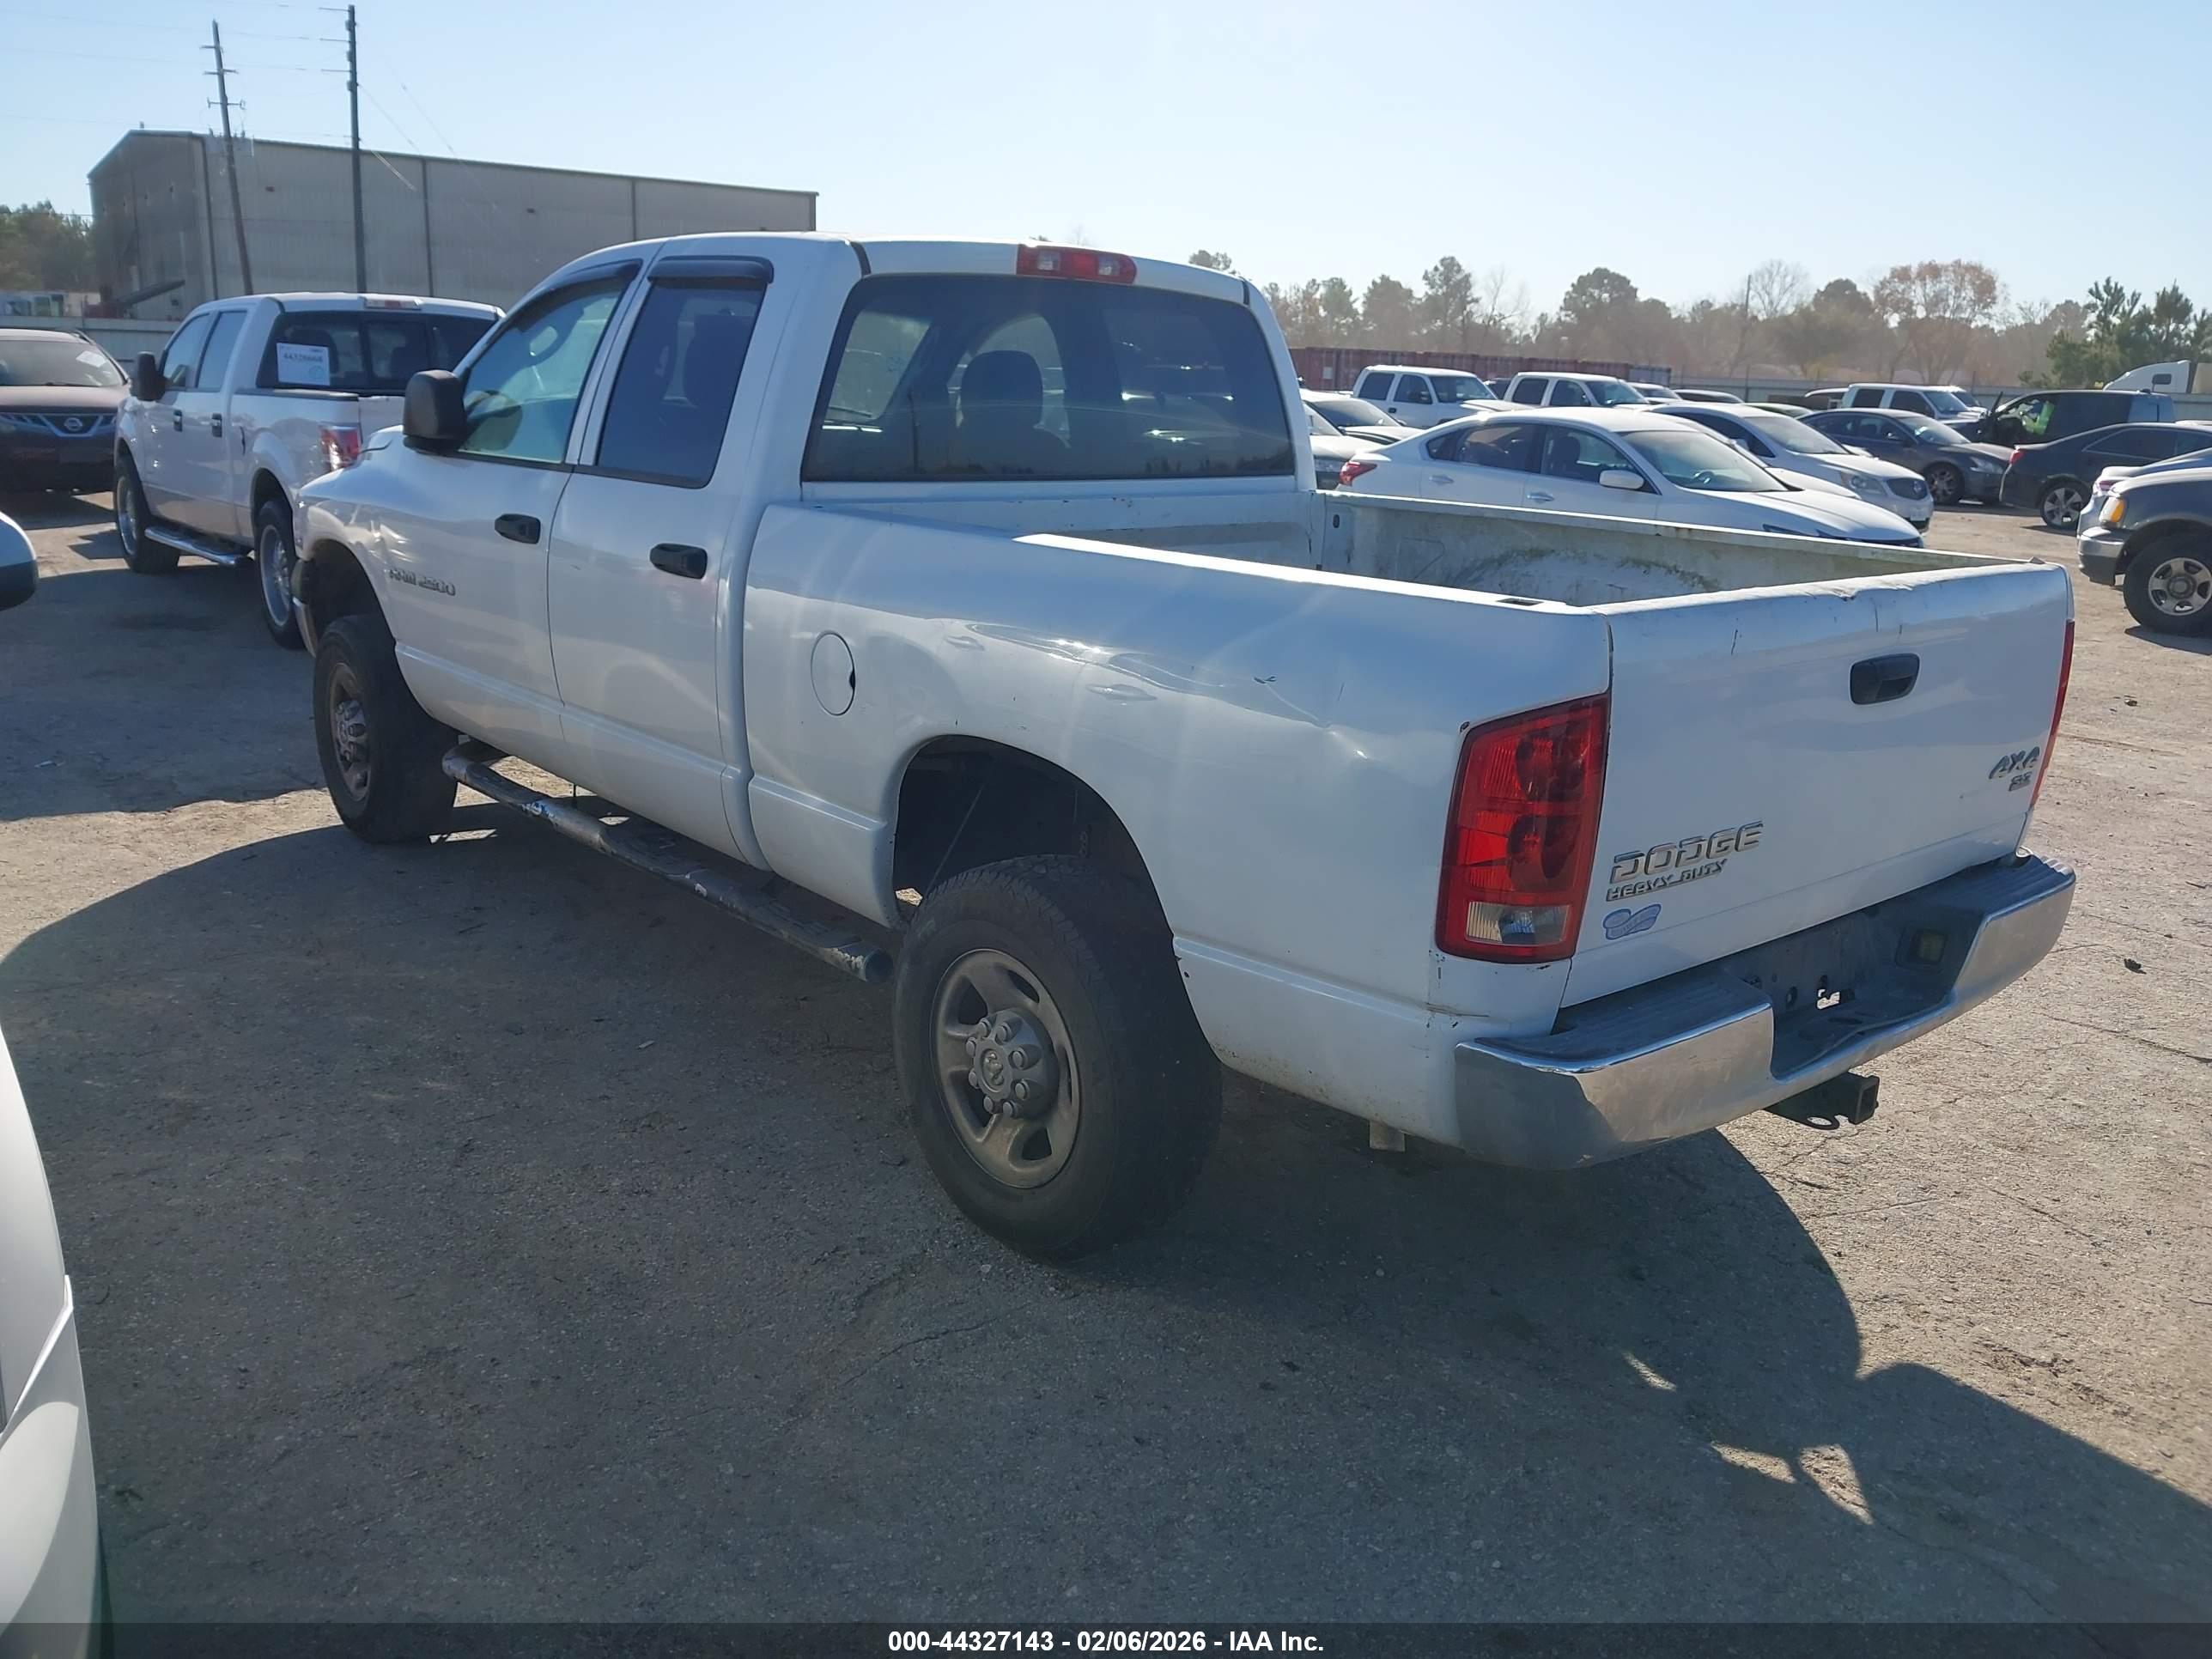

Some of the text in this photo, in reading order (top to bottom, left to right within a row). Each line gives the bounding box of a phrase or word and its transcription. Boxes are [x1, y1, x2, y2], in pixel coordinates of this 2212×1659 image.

[1609, 821, 1764, 884] DODGE
[1606, 859, 1728, 902] HEAVY DUTY
